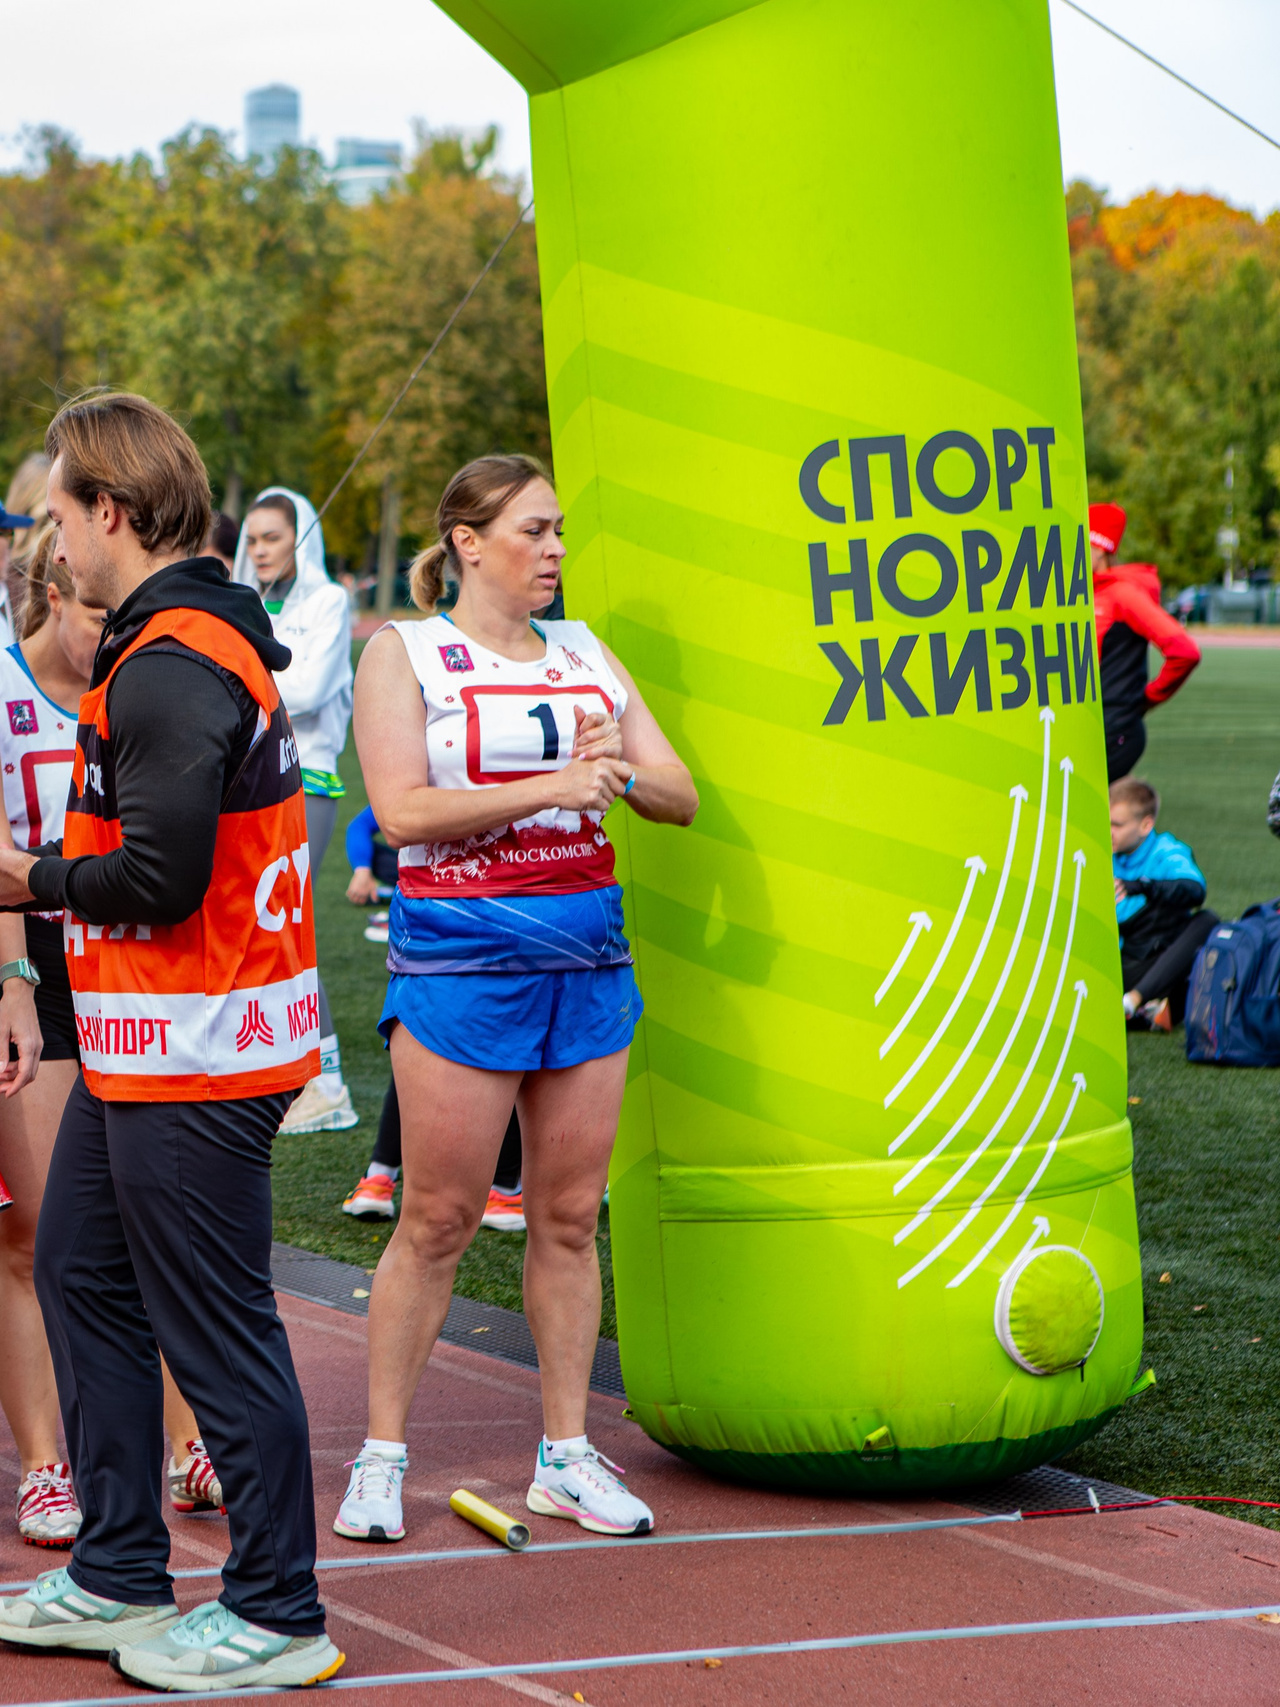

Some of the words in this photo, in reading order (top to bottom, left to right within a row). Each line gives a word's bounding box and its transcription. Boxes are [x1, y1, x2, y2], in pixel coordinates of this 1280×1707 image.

[799, 427, 1056, 524] СПОРТ
[808, 524, 1089, 626] НОРМА
[817, 621, 1097, 726] ЖИЗНИ
[527, 703, 559, 761] 1
[100, 1018, 172, 1055] ПОРТ
